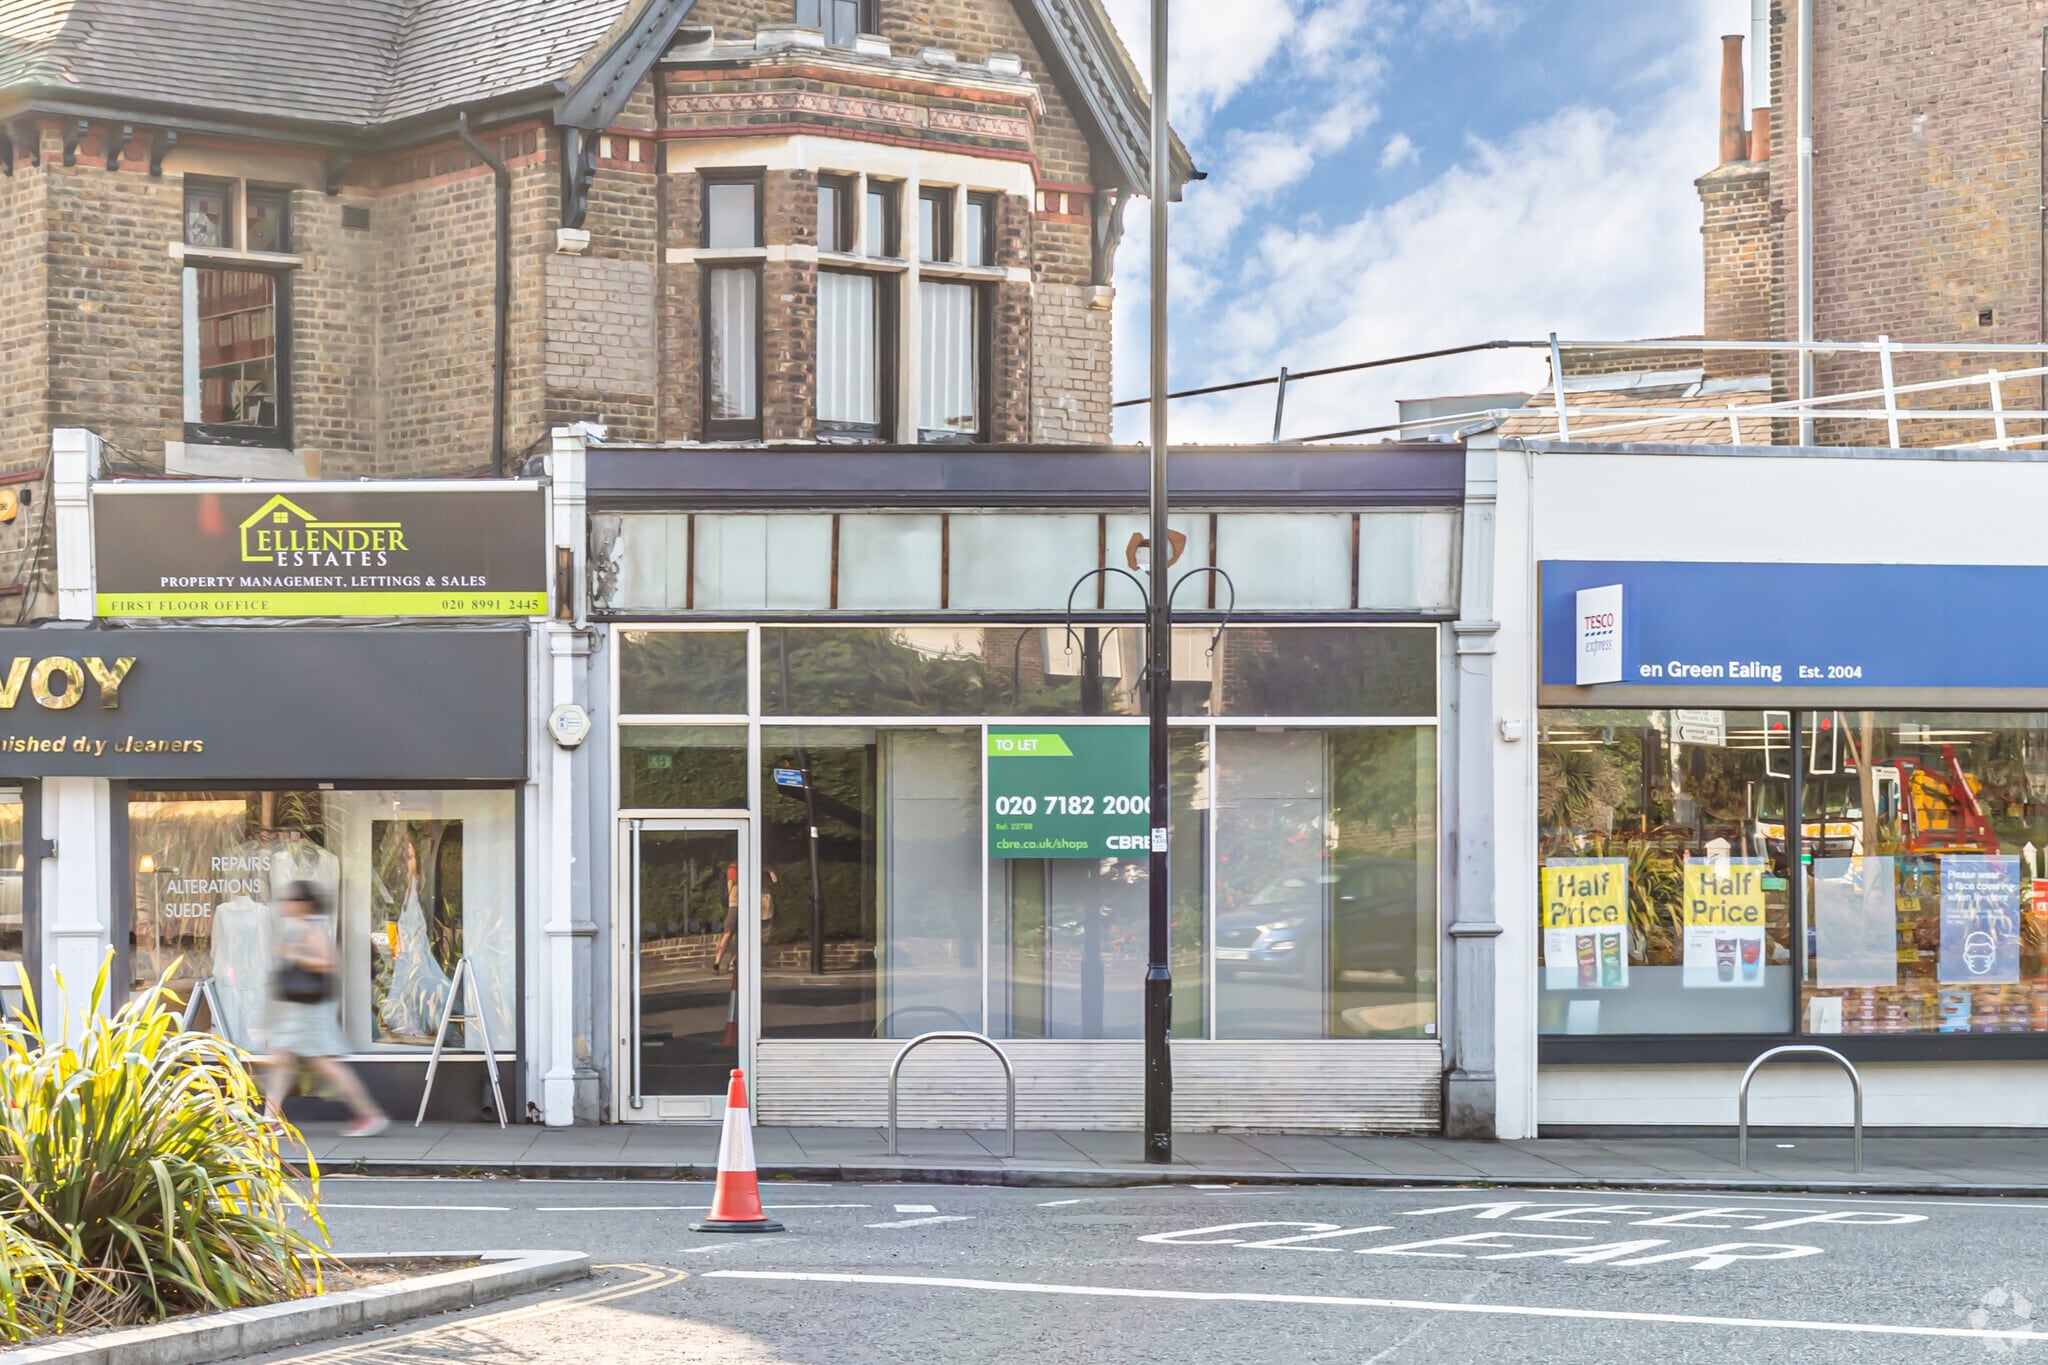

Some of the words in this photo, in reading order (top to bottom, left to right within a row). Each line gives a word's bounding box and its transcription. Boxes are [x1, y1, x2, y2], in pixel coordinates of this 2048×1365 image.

[256, 529, 409, 551] ELLENDER
[277, 551, 388, 567] ESTATES
[160, 576, 235, 587] PROPERTY
[239, 576, 347, 588] MANAGEMENT,
[351, 575, 421, 587] LETTINGS
[425, 576, 436, 587] &
[441, 575, 487, 587] SALES
[111, 600, 153, 611] FIRST
[159, 600, 209, 611] FLOOR
[214, 600, 270, 611] OFFICE
[442, 599, 464, 610] 020
[471, 599, 501, 610] 8991
[508, 599, 540, 610] 2445
[1584, 613, 1614, 629] TESCO
[1638, 664, 1663, 678] en
[1668, 660, 1724, 679] Green
[1729, 660, 1783, 683] Ealing
[1798, 665, 1824, 679] Est.
[1828, 665, 1863, 679] 2004
[72, 735, 108, 757] dry
[115, 735, 205, 754] cleaners
[995, 739, 1014, 751] TO
[1017, 739, 1038, 751] LET
[995, 796, 1037, 815] 020
[1044, 796, 1095, 815] 7182
[996, 838, 1089, 851] cbre.co.uk/shops
[211, 856, 271, 871] REPAIRS
[166, 878, 261, 894] ALTERATIONS
[1557, 872, 1611, 897] Half
[1700, 872, 1752, 896] Half
[165, 903, 212, 918] SUEDE
[1551, 901, 1619, 925] Price
[1692, 900, 1759, 923] Price
[1396, 1201, 1930, 1231] KEEP
[1136, 1221, 1825, 1271] CLEAR
